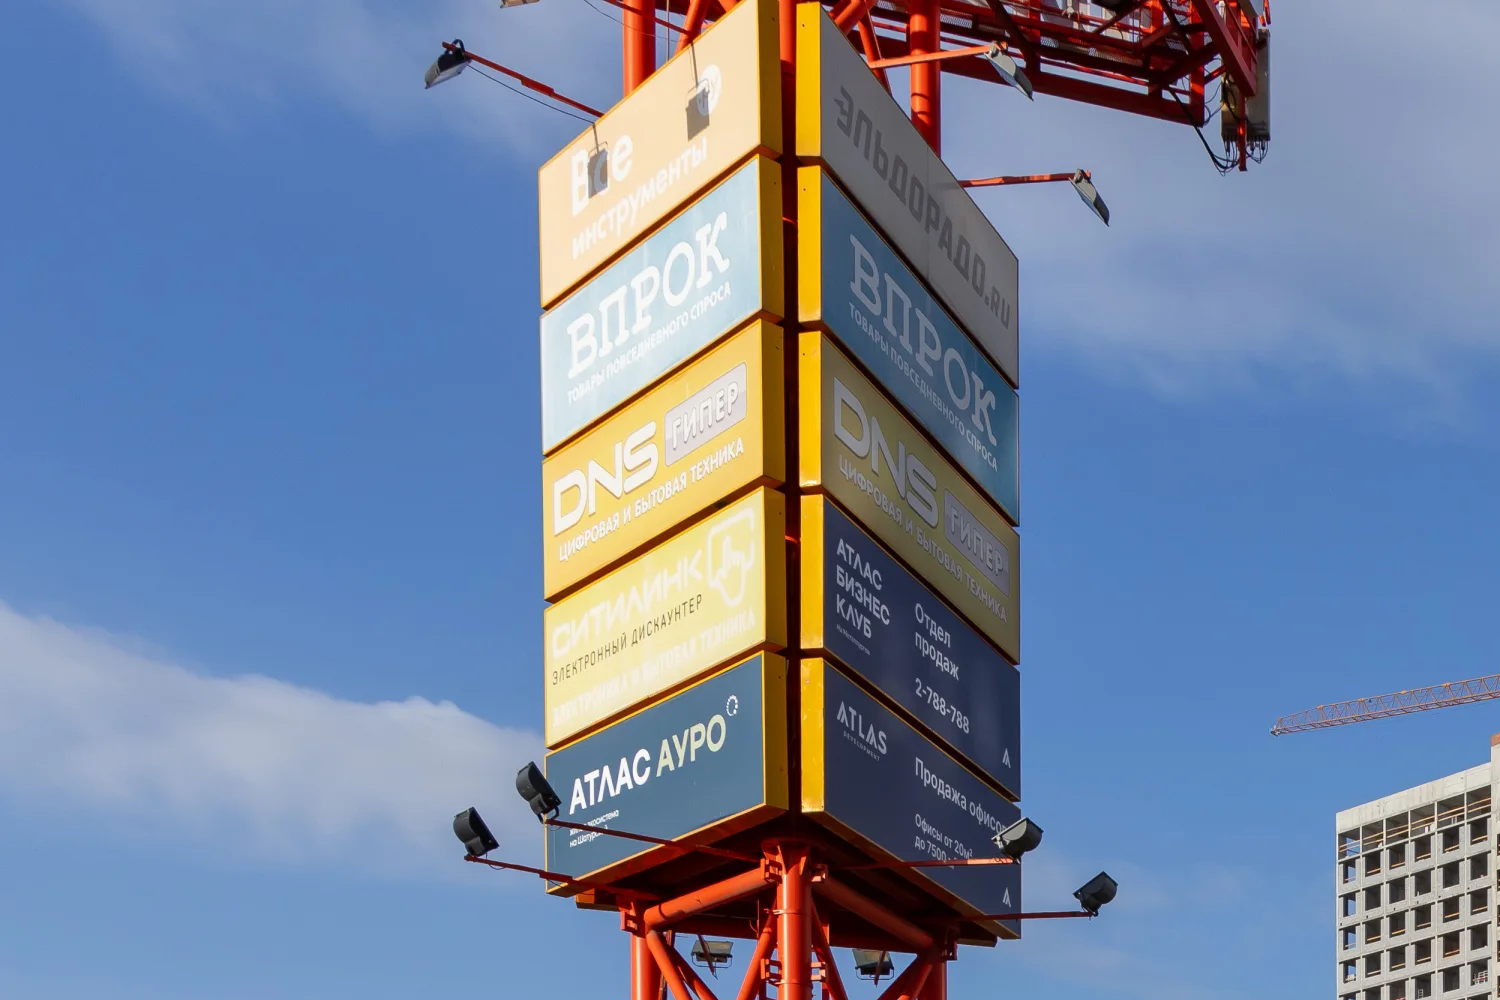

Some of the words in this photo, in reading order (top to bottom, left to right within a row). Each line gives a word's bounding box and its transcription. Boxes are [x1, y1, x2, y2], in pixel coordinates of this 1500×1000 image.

[571, 135, 633, 216] Все
[572, 136, 707, 260] инструменты
[567, 212, 730, 379] ВПРОК
[567, 367, 606, 405] ТОВАРЫ
[606, 313, 689, 380] ПОВСЕДНЕВНОГО
[690, 281, 731, 320] СПРОСА
[849, 233, 998, 447] ВПРОК
[672, 381, 740, 451] ГИПЕР
[849, 301, 889, 356] ТОВАРЫ
[890, 348, 966, 433] ПОВСЕДНЕВНОГО
[966, 431, 998, 472] СПРОСА
[553, 420, 659, 537] DNS
[833, 376, 939, 529] DNS
[559, 511, 620, 562] ЦИФРОВАЯ
[623, 504, 632, 525] И
[634, 472, 687, 519] БЫТОВАЯ
[690, 436, 744, 484] ТЕХНИКА
[838, 454, 902, 528] ЦИФРОВАЯ
[905, 518, 913, 536] И
[916, 526, 963, 585] БЫТОВАЯ
[965, 571, 1008, 623] ТЕХНИКА
[836, 538, 882, 592] АТЛАС
[950, 506, 1004, 578] ГИПЕР
[552, 548, 702, 658] СИТИЛИНК
[836, 564, 890, 626] БИЗНЕС
[836, 593, 872, 639] КЛУБ
[915, 603, 951, 649] Отдел
[552, 632, 627, 686] ЭЛЕКТРОННЫЙ
[631, 593, 703, 647] ДИСКАУНТЕР
[915, 631, 960, 681] продаж
[836, 700, 888, 755] ATLAS
[915, 677, 970, 735] 2-788-788
[569, 748, 651, 816] АТЛАС
[656, 713, 727, 778] АУРО
[915, 756, 967, 811] Продажа
[915, 813, 943, 843] Офисы
[944, 835, 953, 849] от
[915, 835, 926, 851] до
[926, 840, 947, 864] 7500
